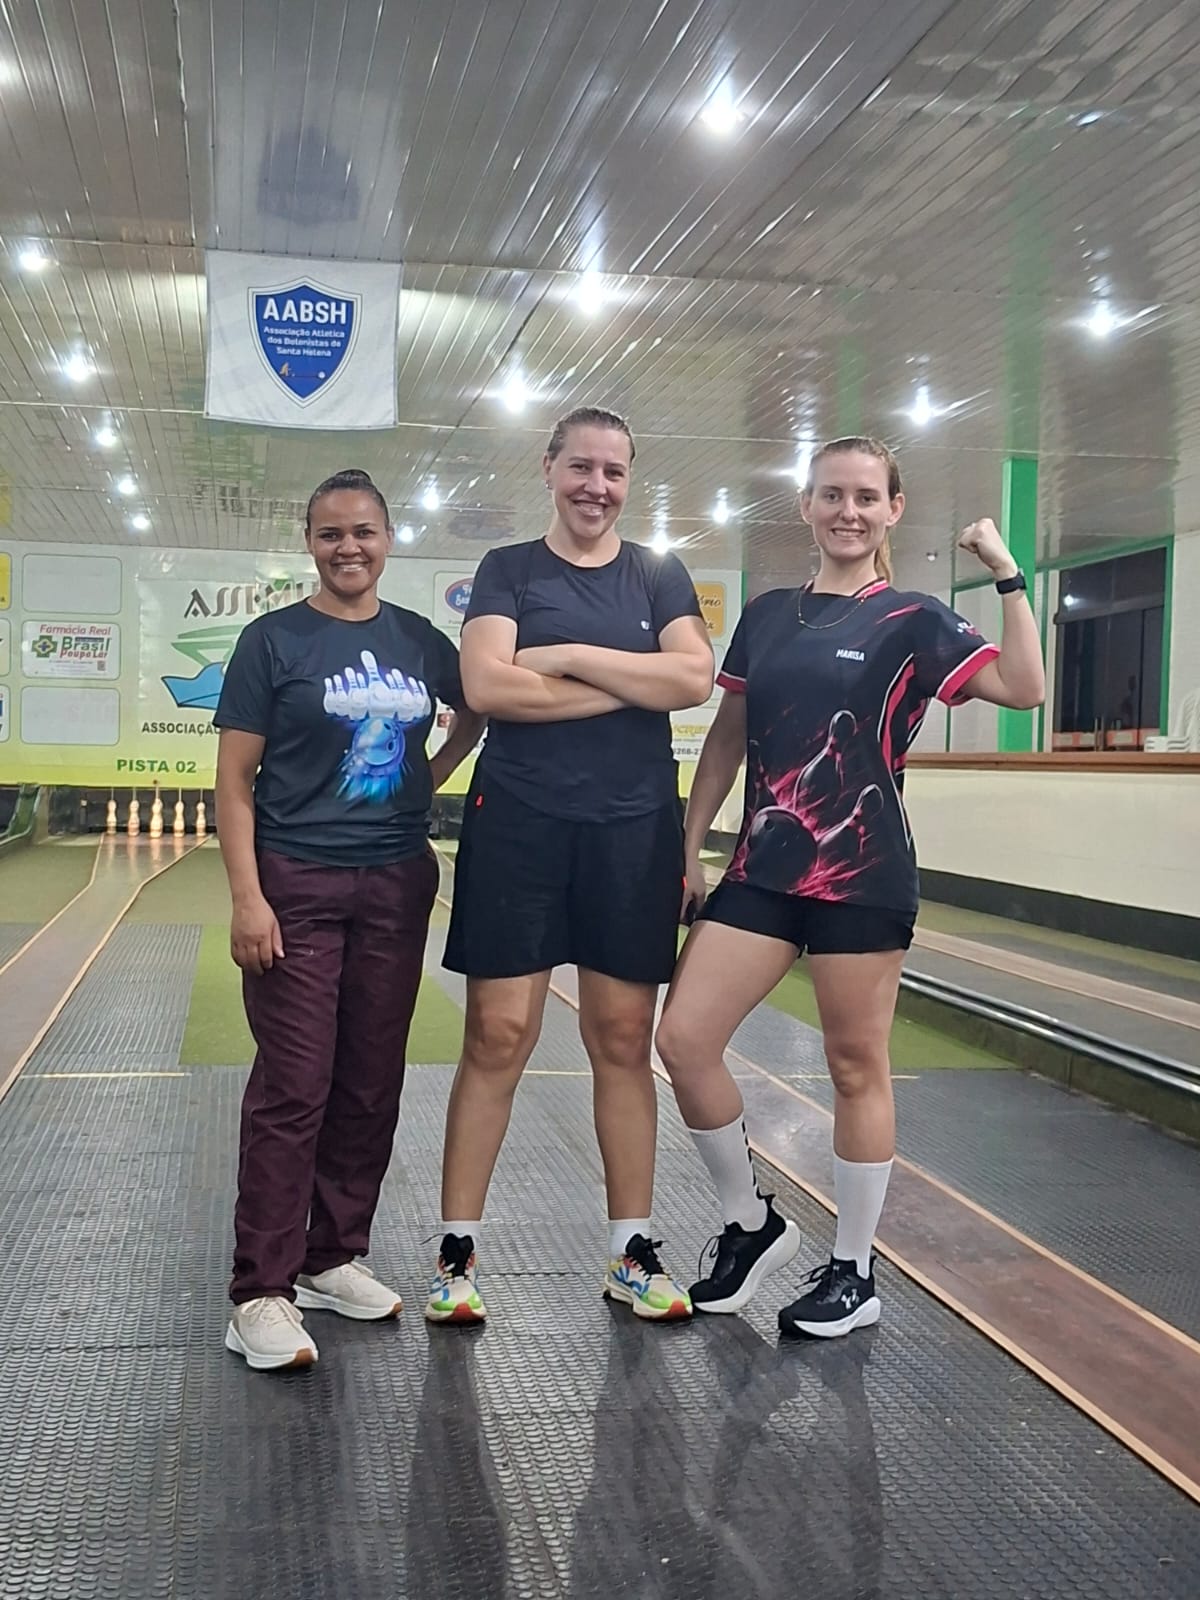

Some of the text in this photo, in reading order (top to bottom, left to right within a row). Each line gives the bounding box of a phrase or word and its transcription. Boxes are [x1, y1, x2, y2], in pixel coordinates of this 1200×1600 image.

[263, 297, 347, 325] AABSH
[267, 336, 282, 345] dos
[330, 340, 341, 348] de
[276, 347, 332, 357] Santa Helena
[40, 624, 111, 635] Farmácia Real
[61, 636, 111, 651] Brasil
[117, 759, 197, 773] PISTA 02
